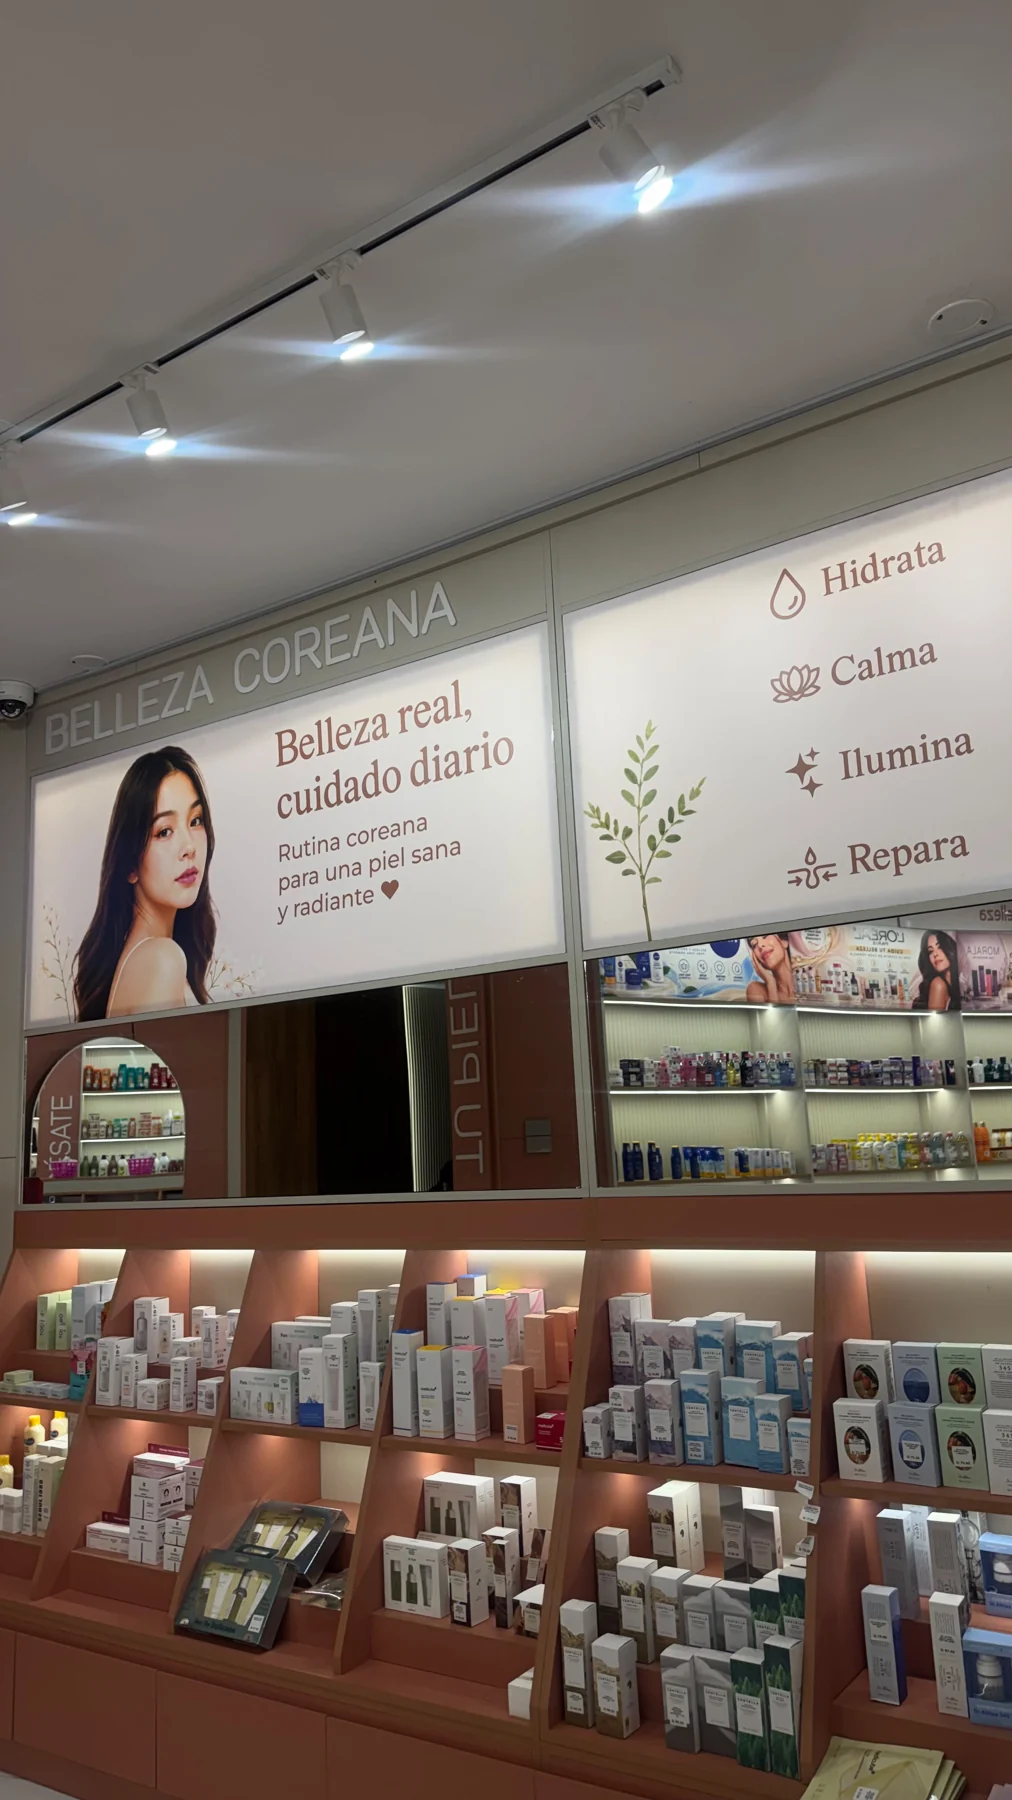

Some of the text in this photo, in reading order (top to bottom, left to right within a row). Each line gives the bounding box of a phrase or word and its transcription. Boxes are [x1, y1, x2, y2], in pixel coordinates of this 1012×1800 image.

[821, 540, 947, 597] Hidrata
[45, 581, 457, 756] BELLEZA COREANA
[830, 641, 938, 686] Calma
[274, 679, 473, 768] Belleza real,
[276, 731, 514, 819] cuidado diario
[839, 731, 975, 781] Ilumina
[278, 815, 428, 862] Rutina coreana
[847, 833, 970, 878] Repara
[278, 839, 462, 896] para una piel sana
[277, 886, 374, 925] y radiante
[49, 1095, 73, 1178] SATE
